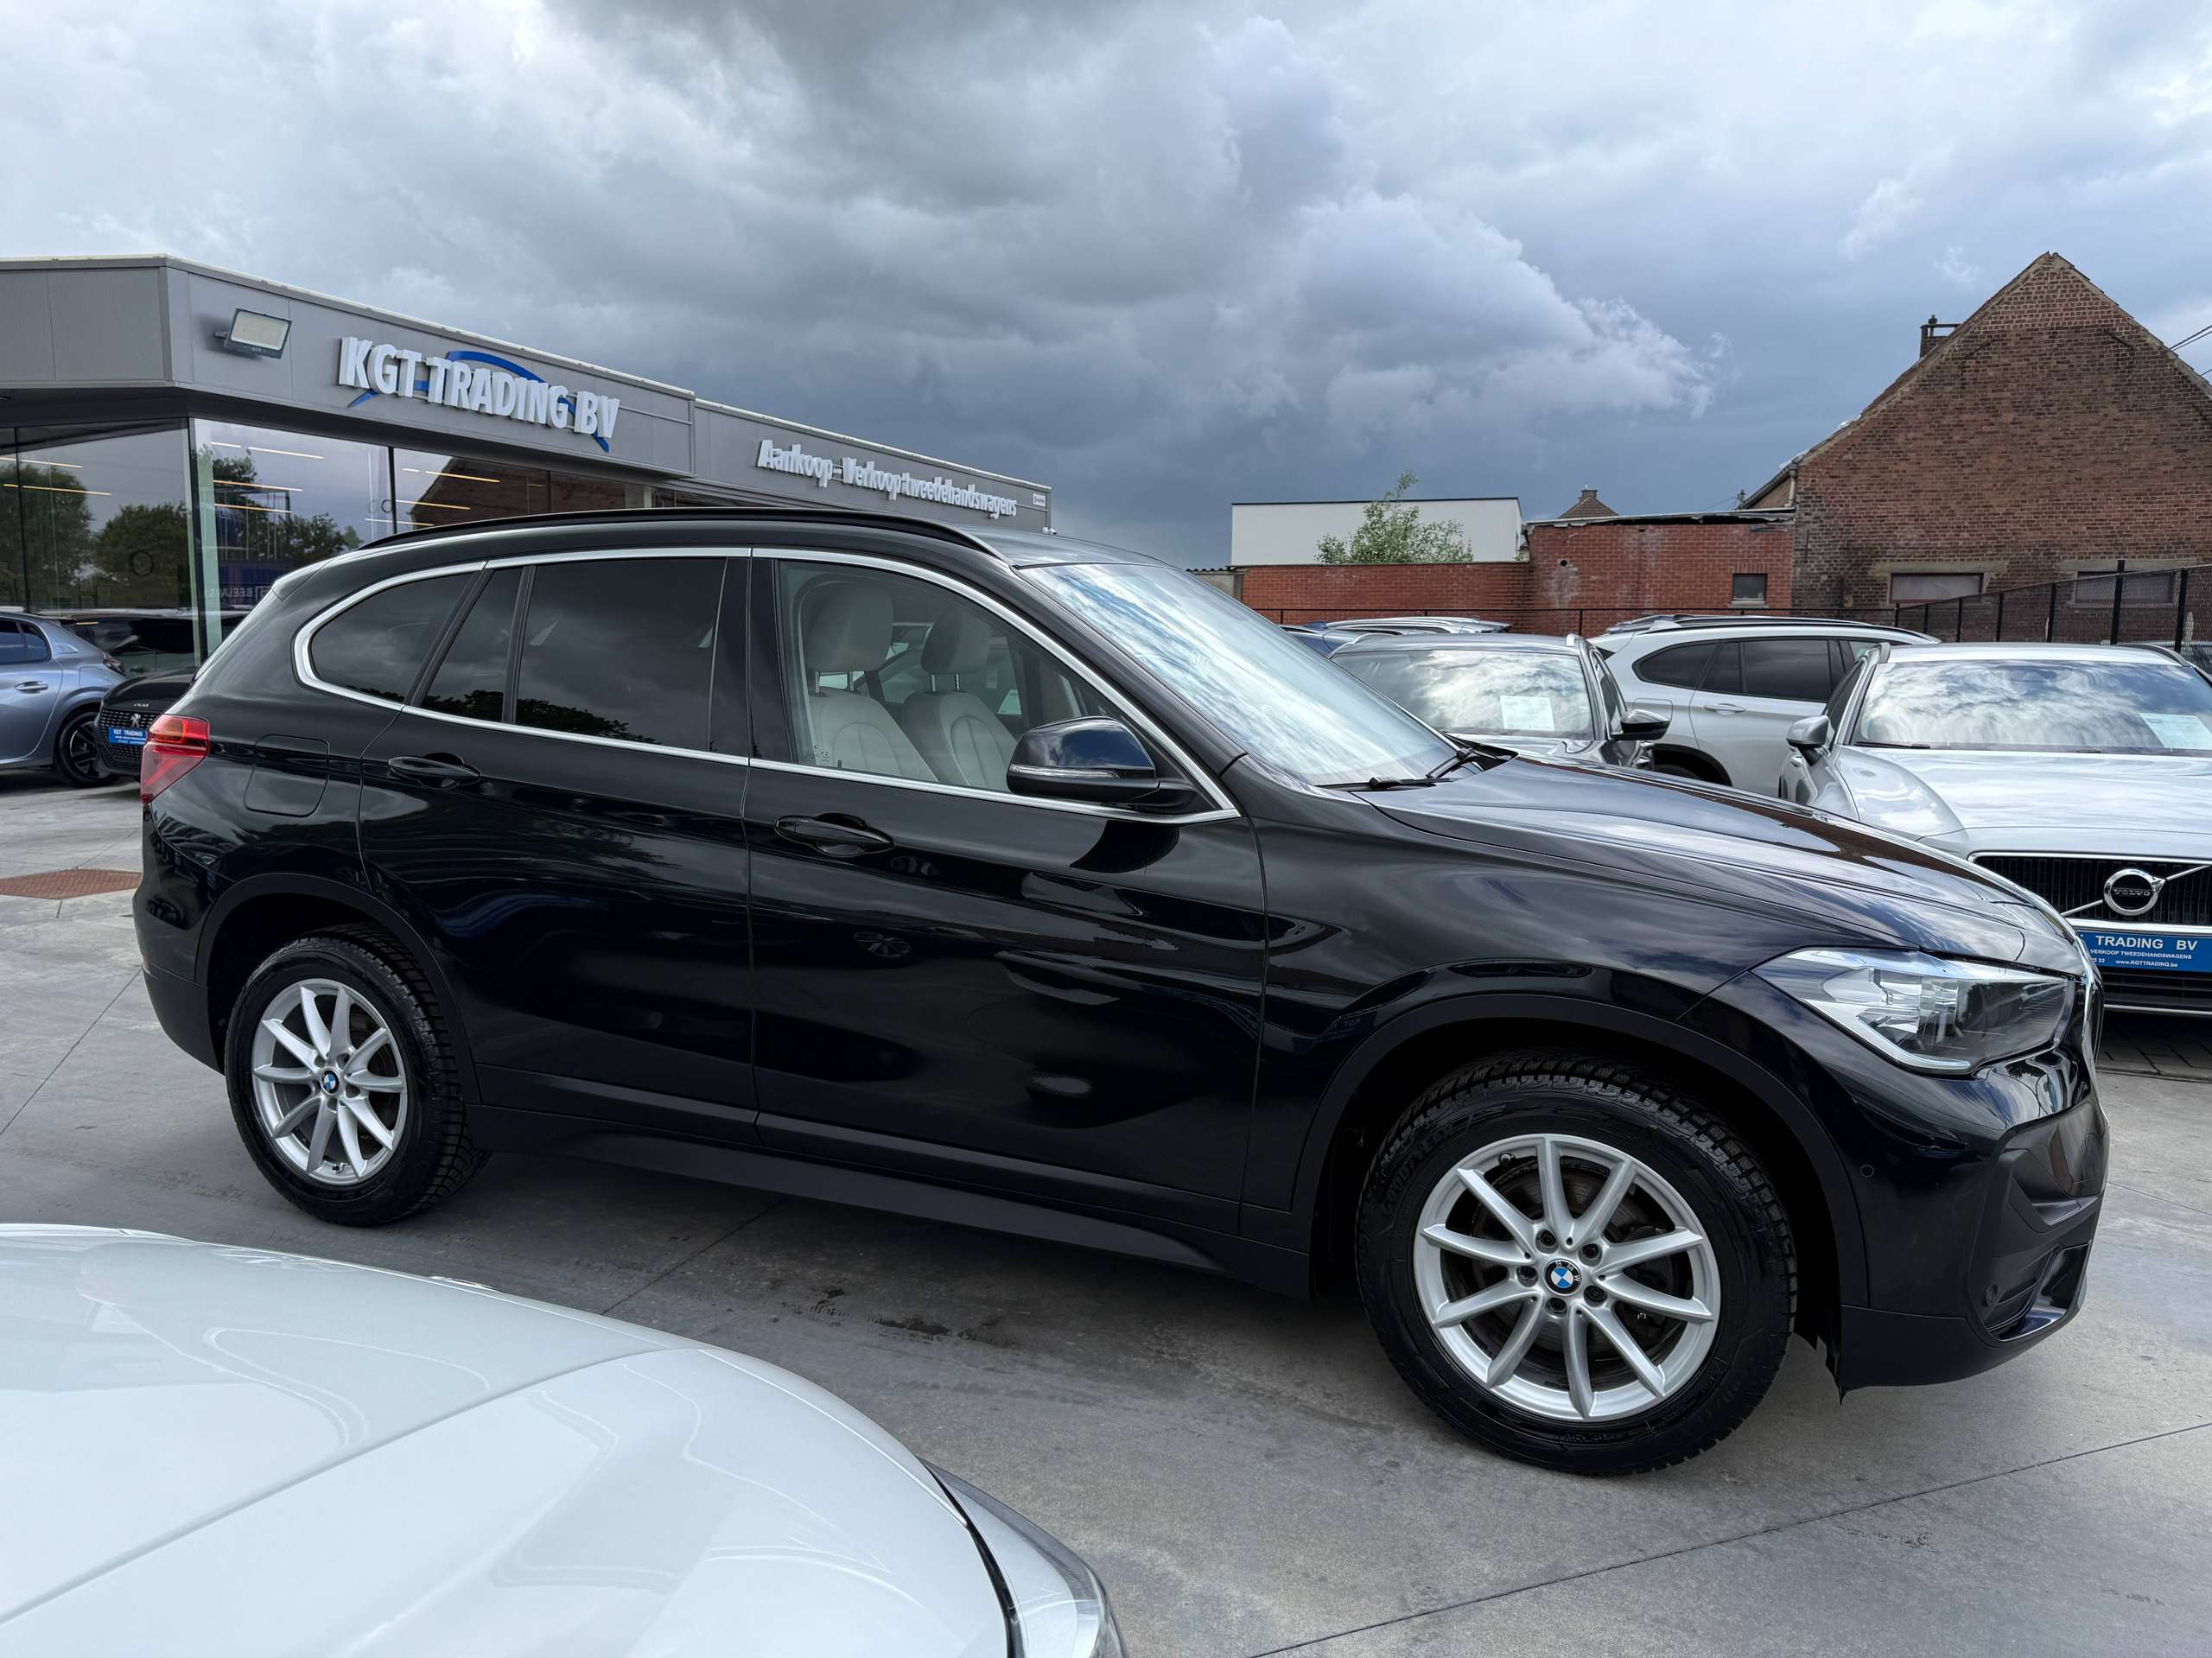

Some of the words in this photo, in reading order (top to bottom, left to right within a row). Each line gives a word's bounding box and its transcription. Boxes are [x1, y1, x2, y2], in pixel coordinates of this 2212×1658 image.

[339, 336, 423, 398] KGT
[426, 356, 569, 429] TRADING
[574, 391, 620, 439] BV
[902, 472, 1017, 519] tweedehandswagens
[2113, 888, 2151, 897] VOLVO
[2094, 935, 2164, 950] TRADING
[2176, 939, 2198, 951] BV
[2120, 950, 2192, 960] TWEEDEHANDSWAGENS
